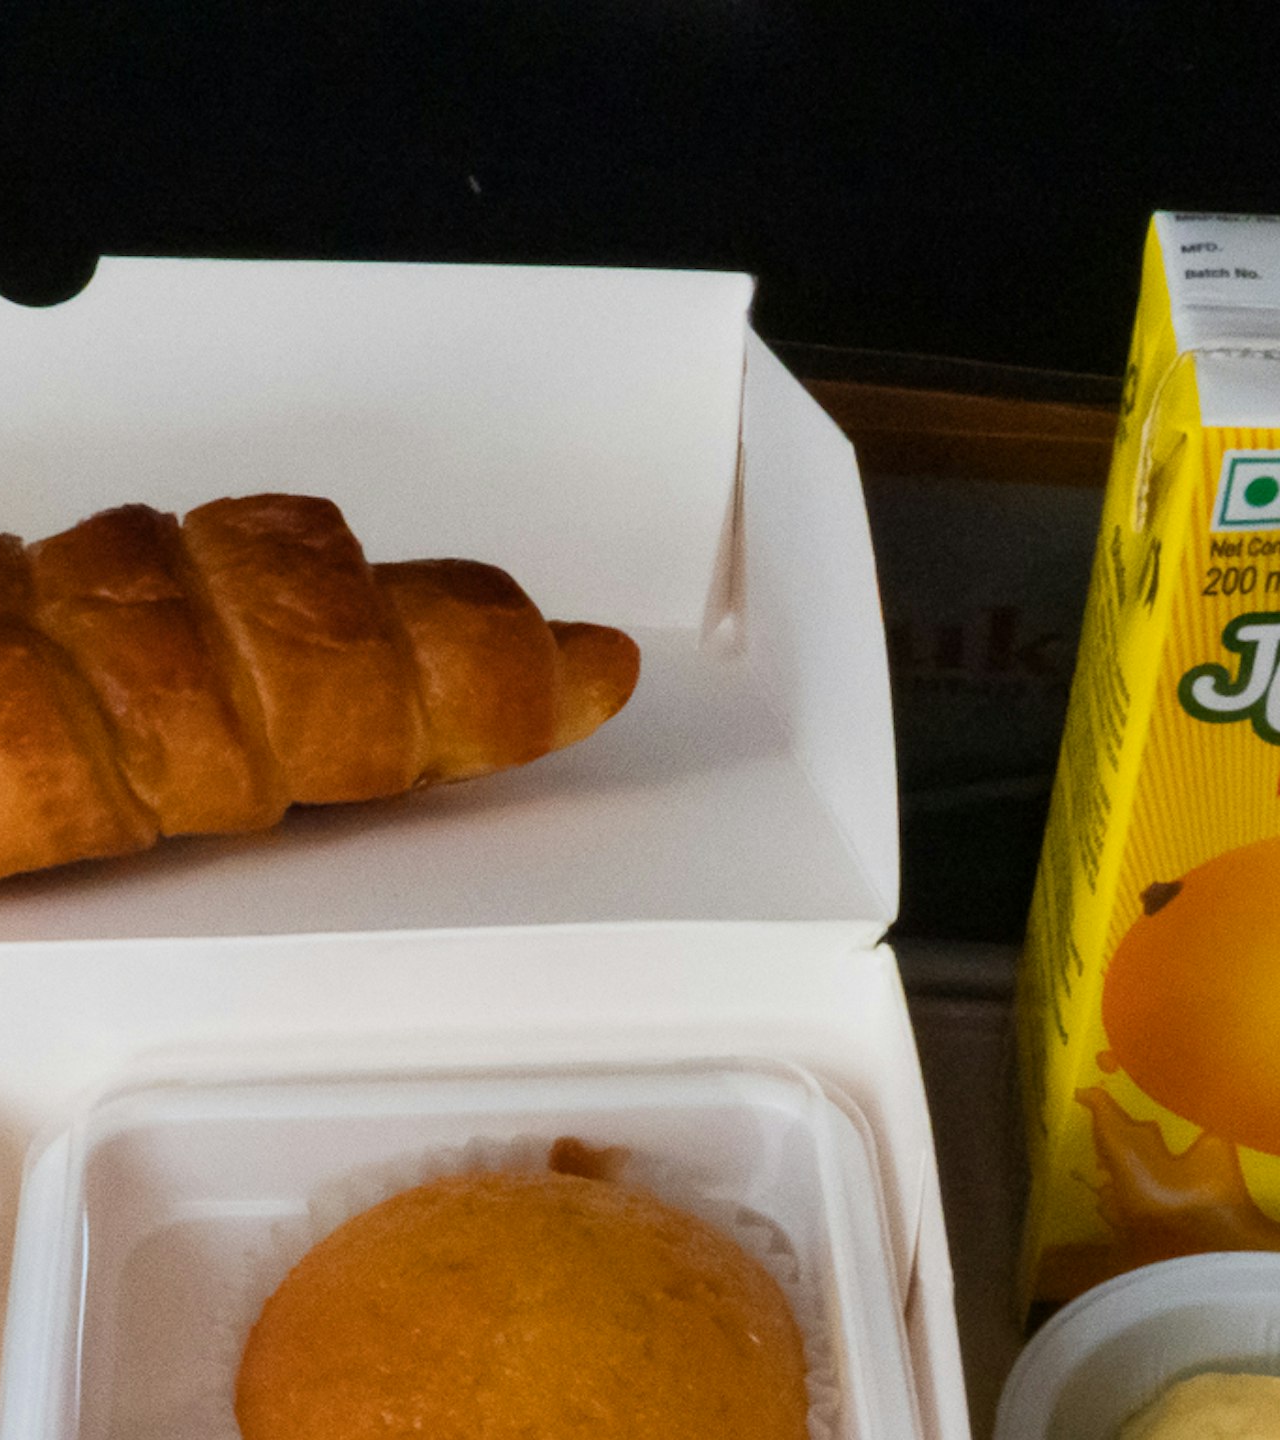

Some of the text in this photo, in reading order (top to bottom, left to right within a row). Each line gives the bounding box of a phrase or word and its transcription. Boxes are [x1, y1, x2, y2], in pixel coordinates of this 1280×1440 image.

[1184, 267, 1230, 279] Batch
[1210, 539, 1243, 560] Net
[1202, 564, 1258, 597] 200
